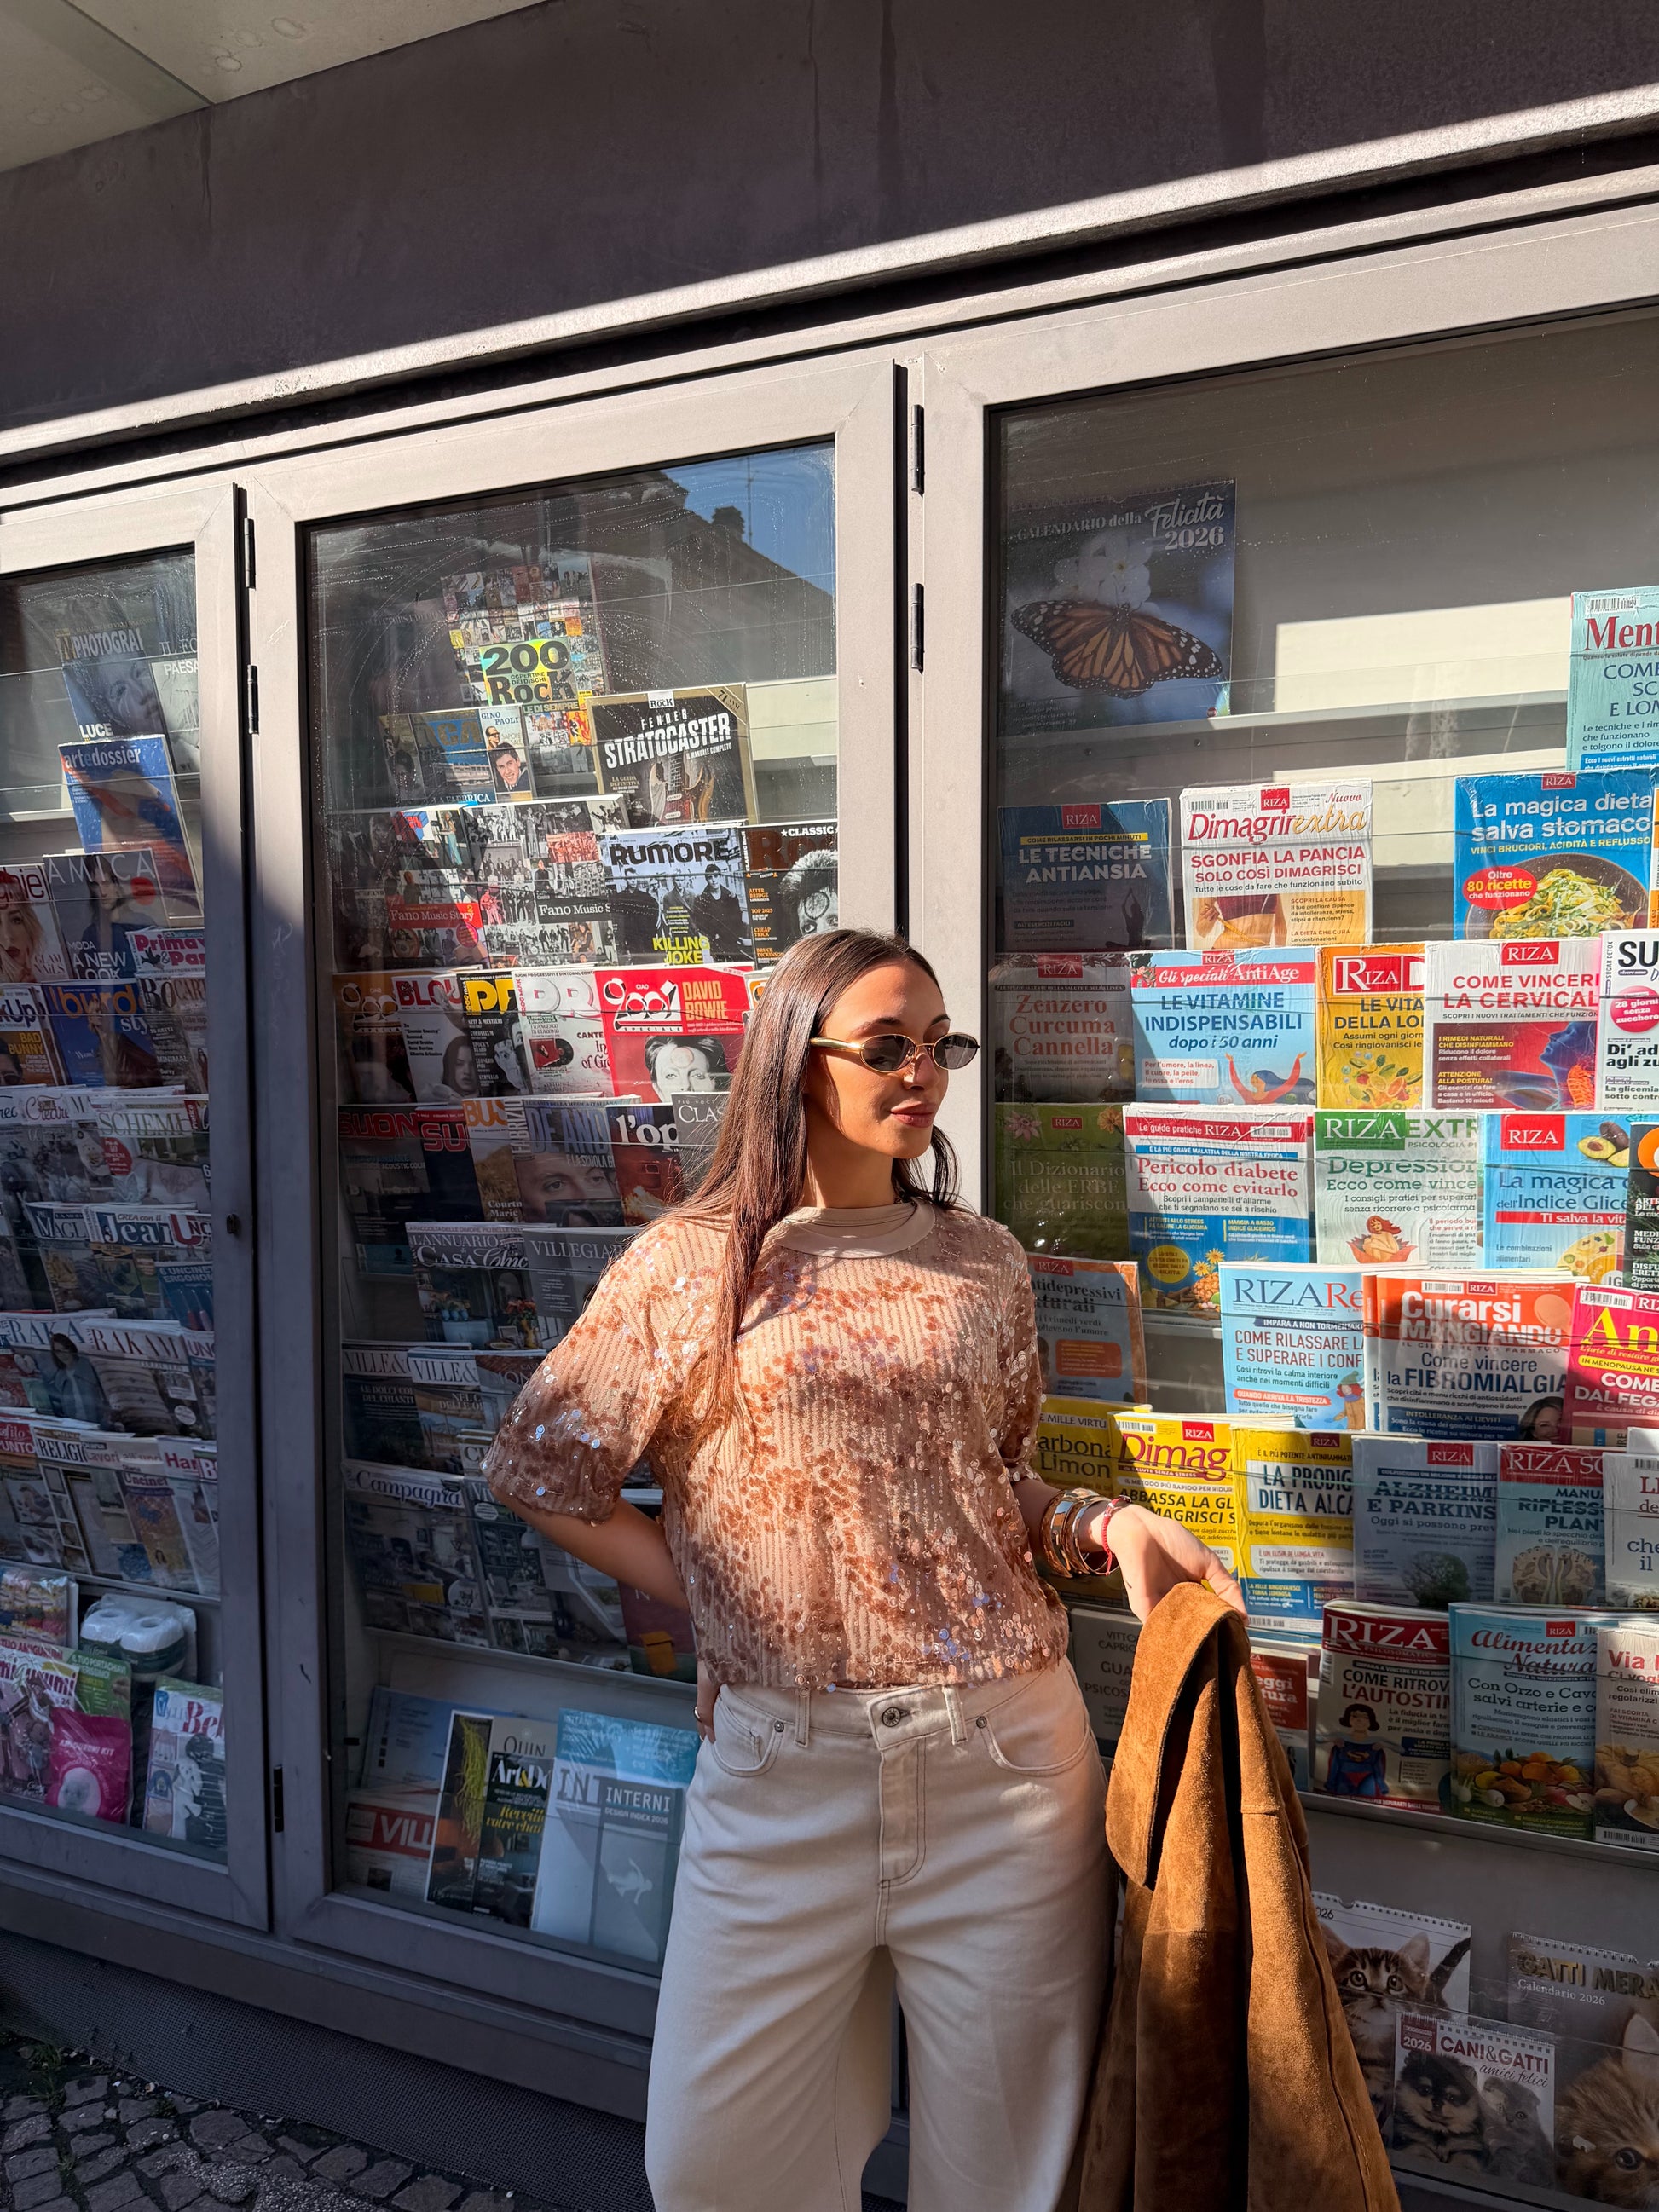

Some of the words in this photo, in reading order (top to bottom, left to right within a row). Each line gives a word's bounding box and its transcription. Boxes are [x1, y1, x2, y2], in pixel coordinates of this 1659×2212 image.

[1017, 517, 1107, 540] CALENDARIO
[1109, 511, 1142, 527] della
[1145, 492, 1225, 536] Felicità
[1165, 526, 1224, 551] 2026
[483, 641, 569, 676] 200
[546, 702, 579, 711] SEMPRE
[641, 709, 688, 730] FENDER
[79, 723, 113, 738] LUCE
[1600, 731, 1650, 741] funzionano
[604, 713, 731, 769] STRATOCASTER
[710, 742, 732, 754] COMPLETO
[64, 748, 141, 768] artedossier
[1546, 776, 1572, 786] RIZA
[1263, 797, 1288, 807] RIZA
[1325, 792, 1362, 803] Nuovo
[1472, 800, 1497, 818] La
[1505, 795, 1587, 817] magica
[1594, 793, 1652, 810] dieta
[788, 826, 834, 837] CLASSIC
[1471, 819, 1534, 842] salva
[1541, 817, 1650, 838] stomaco
[609, 840, 730, 866] RUMORE
[1019, 849, 1041, 864] LE
[1045, 845, 1152, 863] TECNICHE
[1471, 846, 1495, 855] VINCI
[1499, 843, 1547, 852] BRUCIORI,
[1549, 838, 1587, 850] ACIDITÀ
[1598, 837, 1650, 846] REFLUSSO
[1191, 852, 1269, 868] SGONFIA
[1274, 851, 1294, 863] LA
[1299, 846, 1366, 861] PANCIA
[49, 852, 155, 884] AMICA
[1026, 863, 1147, 884] ANTIANSIA
[1195, 870, 1233, 883] SOLO
[1236, 866, 1270, 881] COSÌ
[1274, 864, 1361, 879] DIMAGRISCI
[1488, 870, 1512, 879] Oltre
[1194, 885, 1214, 893] Tutte
[1290, 880, 1335, 888] funzionano
[1467, 881, 1483, 891] 80
[1488, 878, 1532, 890] ricette
[539, 905, 570, 916] Fano
[573, 904, 604, 914] Music
[68, 940, 96, 950] MODA
[652, 936, 710, 951] KILLING
[72, 954, 82, 967] A
[91, 951, 126, 967] NEW
[664, 950, 703, 965] JOKE
[1507, 946, 1555, 961] RIZA
[76, 968, 120, 979] LOOK
[1159, 970, 1177, 983] Gli
[1230, 967, 1299, 983] AntiAge
[1337, 958, 1398, 991] RIZA
[1453, 975, 1512, 989] COME
[682, 980, 722, 1000] DAVID
[1016, 995, 1107, 1014] Zenzero
[1161, 995, 1183, 1010] LE
[1186, 992, 1285, 1010] VITAMINE
[1443, 992, 1472, 1008] LA
[1615, 1000, 1628, 1008] 28
[1631, 997, 1659, 1010] giorni
[685, 1001, 728, 1021] BOWIE
[1623, 1007, 1650, 1015] senza
[1009, 1016, 1115, 1034] Curcuma
[1145, 1014, 1302, 1031] INDISPENSABILI
[1334, 1016, 1394, 1029] DELLA
[20, 1032, 40, 1042] BAD
[1014, 1037, 1113, 1055] Cannella
[1169, 1036, 1208, 1052] dopo
[1220, 1035, 1240, 1048] 50
[1241, 1035, 1278, 1048] anni
[8, 1043, 43, 1054] BUNNY
[1606, 1056, 1639, 1069] agli
[1150, 1124, 1171, 1134] guide
[1172, 1126, 1202, 1135] pratiche
[1204, 1125, 1241, 1137] RIZA
[1324, 1118, 1402, 1139] RIZA
[1508, 1130, 1558, 1144] RIZA
[1030, 1161, 1124, 1176] Dizionario
[1137, 1158, 1217, 1175] Pericolo
[1223, 1161, 1298, 1181] diabete
[1019, 1180, 1061, 1194] delle
[1068, 1180, 1119, 1194] ERBE
[1138, 1178, 1176, 1192] Ecco
[1182, 1182, 1228, 1193] come
[1232, 1182, 1298, 1198] evitarlo
[1326, 1180, 1367, 1191] Ecco
[1373, 1180, 1422, 1189] come
[1498, 1171, 1523, 1188] La
[1531, 1174, 1616, 1193] magica
[411, 1232, 499, 1249] L'ANNUARIO
[416, 1245, 477, 1268] CASA
[1401, 1291, 1521, 1323] Curarsi
[1235, 1331, 1271, 1346] COME
[1276, 1333, 1348, 1350] RILASSARE
[1402, 1319, 1561, 1345] MANGIANDO
[92, 1328, 179, 1359] RAKAM
[1247, 1349, 1315, 1367] SUPERARE
[1421, 1353, 1469, 1369] Come
[1475, 1355, 1538, 1372] vincere
[1387, 1371, 1401, 1385] la
[1404, 1368, 1568, 1394] FIBROMIALGIA
[1044, 1415, 1075, 1426] MILLE
[1507, 1452, 1573, 1473] RIZA
[356, 1470, 462, 1508] Campagna
[1120, 1488, 1188, 1506] ABBASSA
[1258, 1489, 1307, 1512] DIETA
[1371, 1516, 1399, 1527] Oggi
[1417, 1520, 1466, 1530] possono
[1327, 1614, 1437, 1650] RIZA
[1609, 1650, 1645, 1670] Via
[1468, 1678, 1500, 1692] Con
[1505, 1683, 1541, 1698] Orzo
[1473, 1694, 1512, 1707] salvi
[1516, 1699, 1569, 1712] arterie
[1609, 1694, 1657, 1704] regolarizzi
[604, 1785, 672, 1813] INTERNI
[604, 1808, 628, 1819] DESIGN
[629, 1811, 650, 1822] INDEX
[651, 1814, 669, 1825] 2026
[1517, 1978, 1576, 2001] Calendario
[1579, 1993, 1605, 2006] 2026
[1402, 2036, 1432, 2052] 2026
[1439, 2036, 1549, 2075] CANI&GATTI
[1478, 2063, 1516, 2081] amici
[1517, 2068, 1548, 2089] felici
